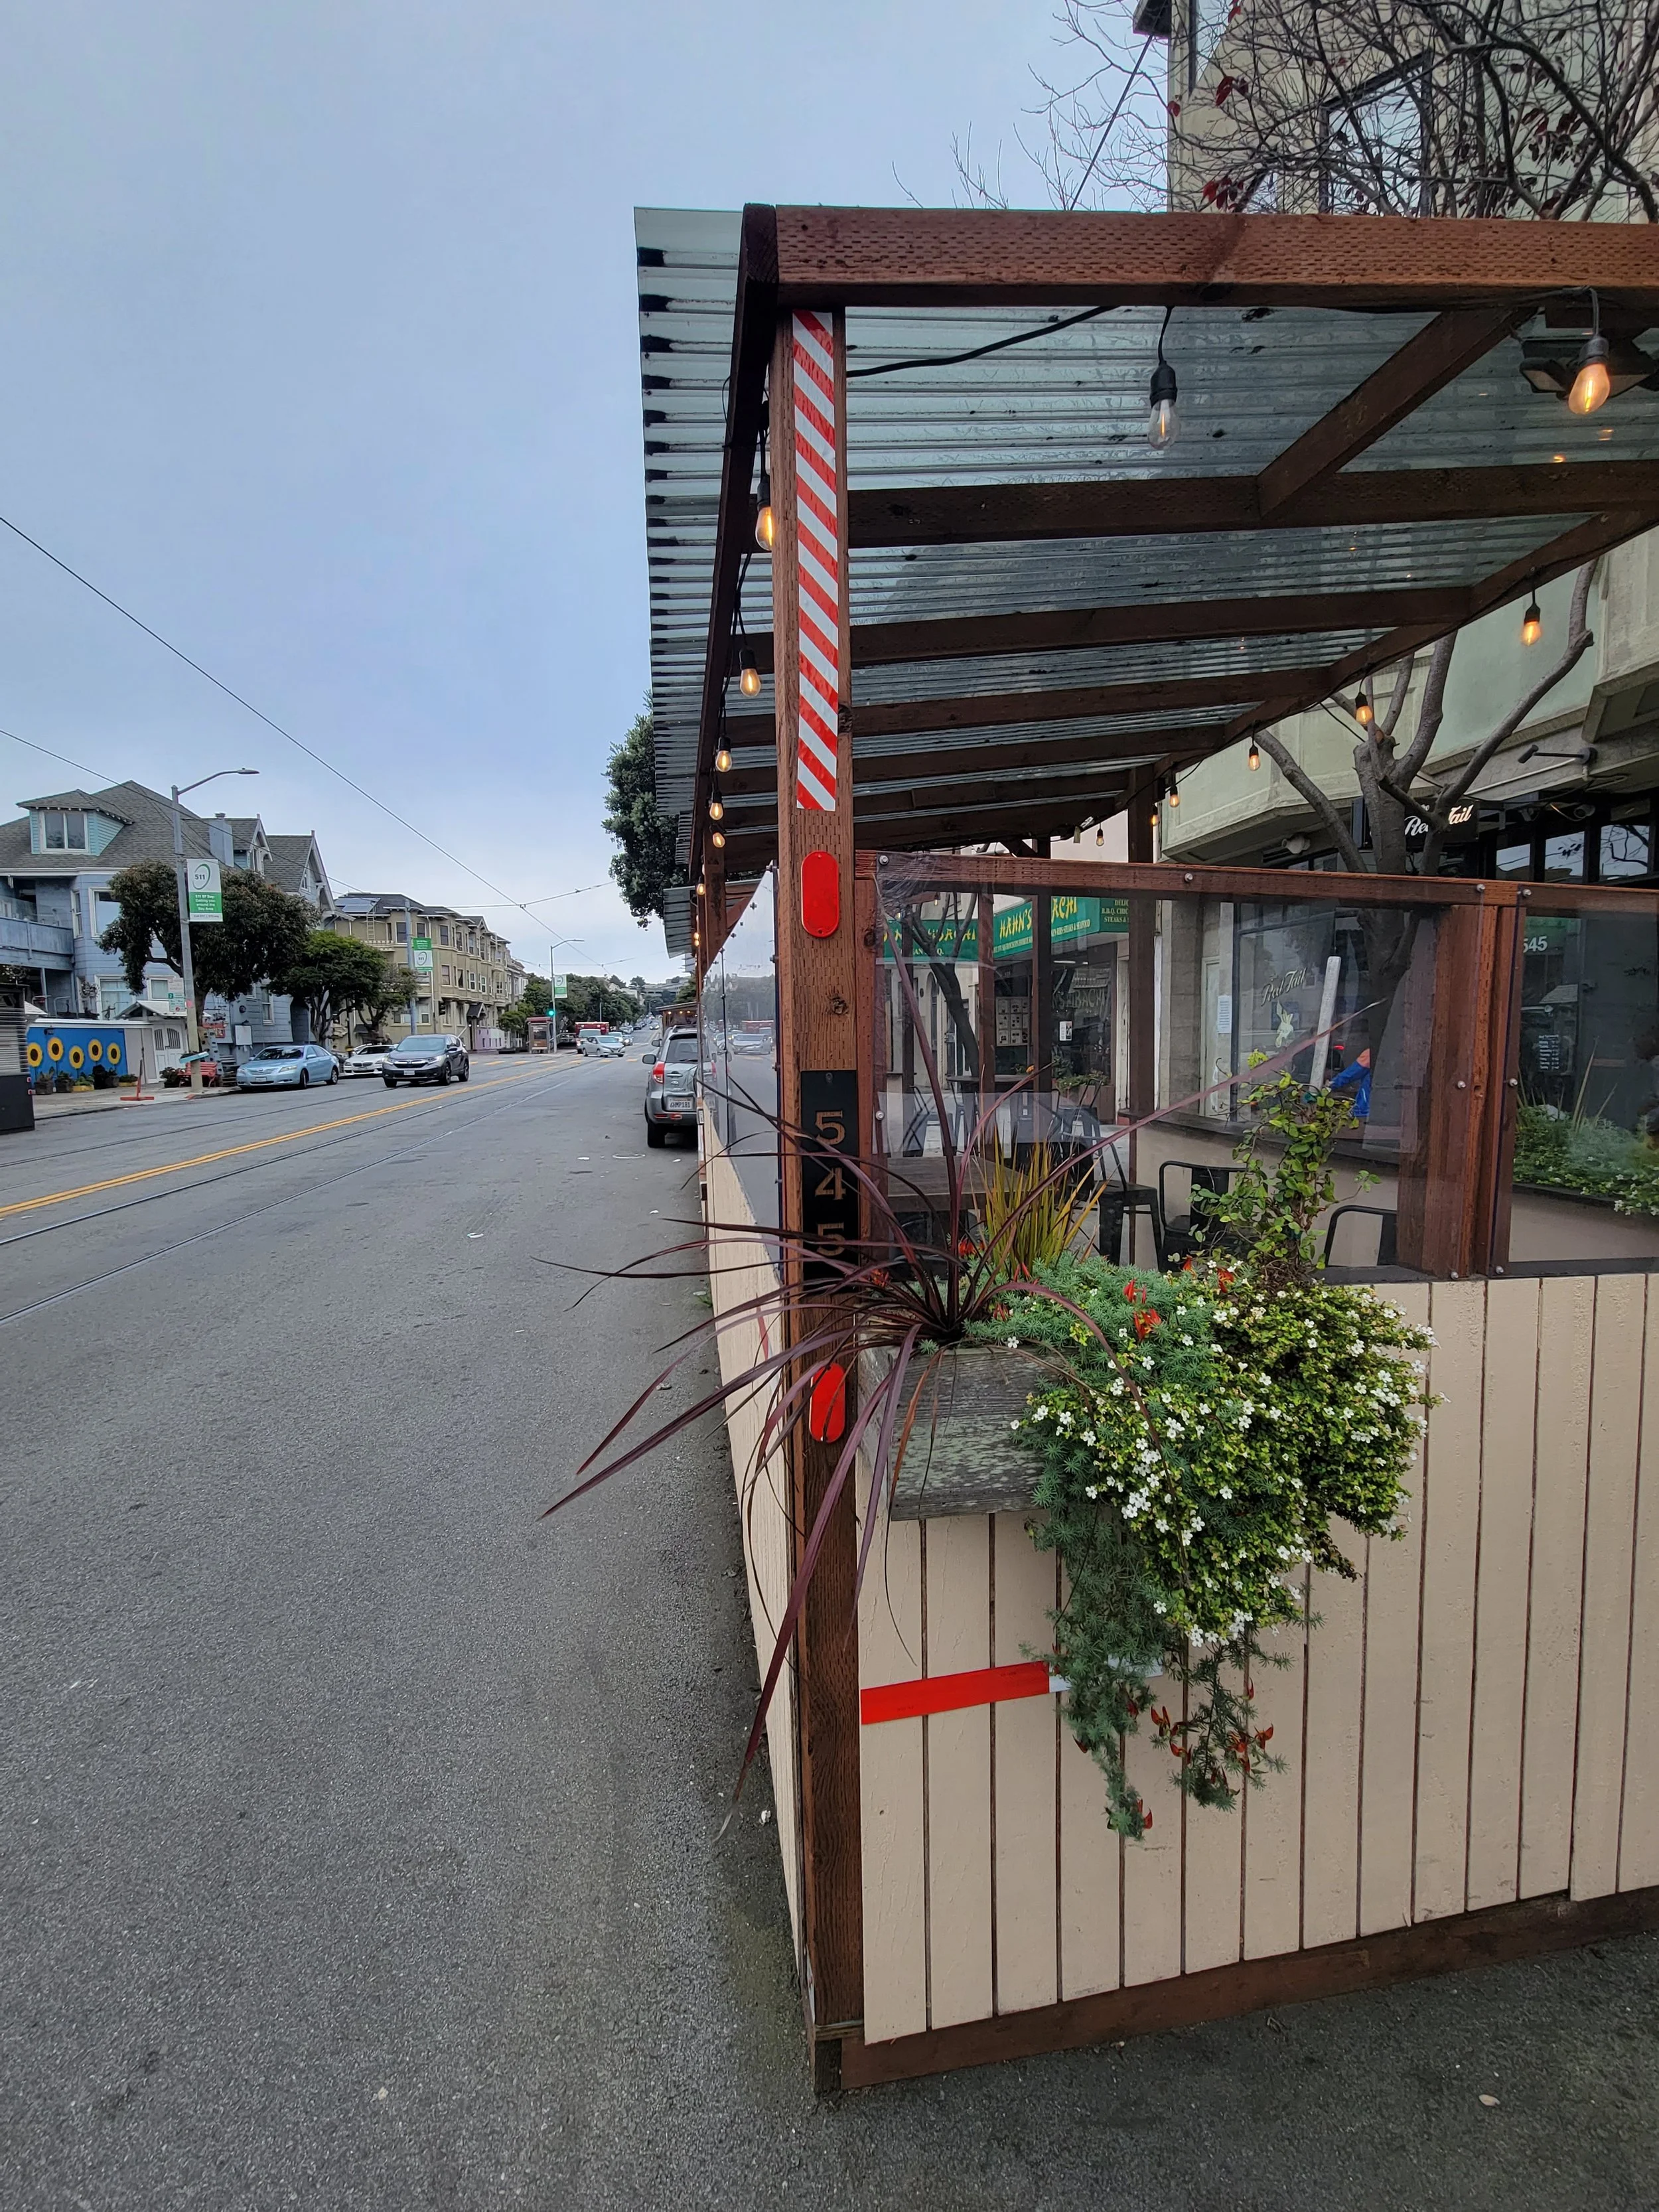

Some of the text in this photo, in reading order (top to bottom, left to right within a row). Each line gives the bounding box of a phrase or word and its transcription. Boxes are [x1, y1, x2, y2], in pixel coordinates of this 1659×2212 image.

[1449, 804, 1474, 825] Tail
[1051, 896, 1078, 924] ACHI
[1523, 936, 1548, 953] 545
[1261, 967, 1307, 1007] Red Tail
